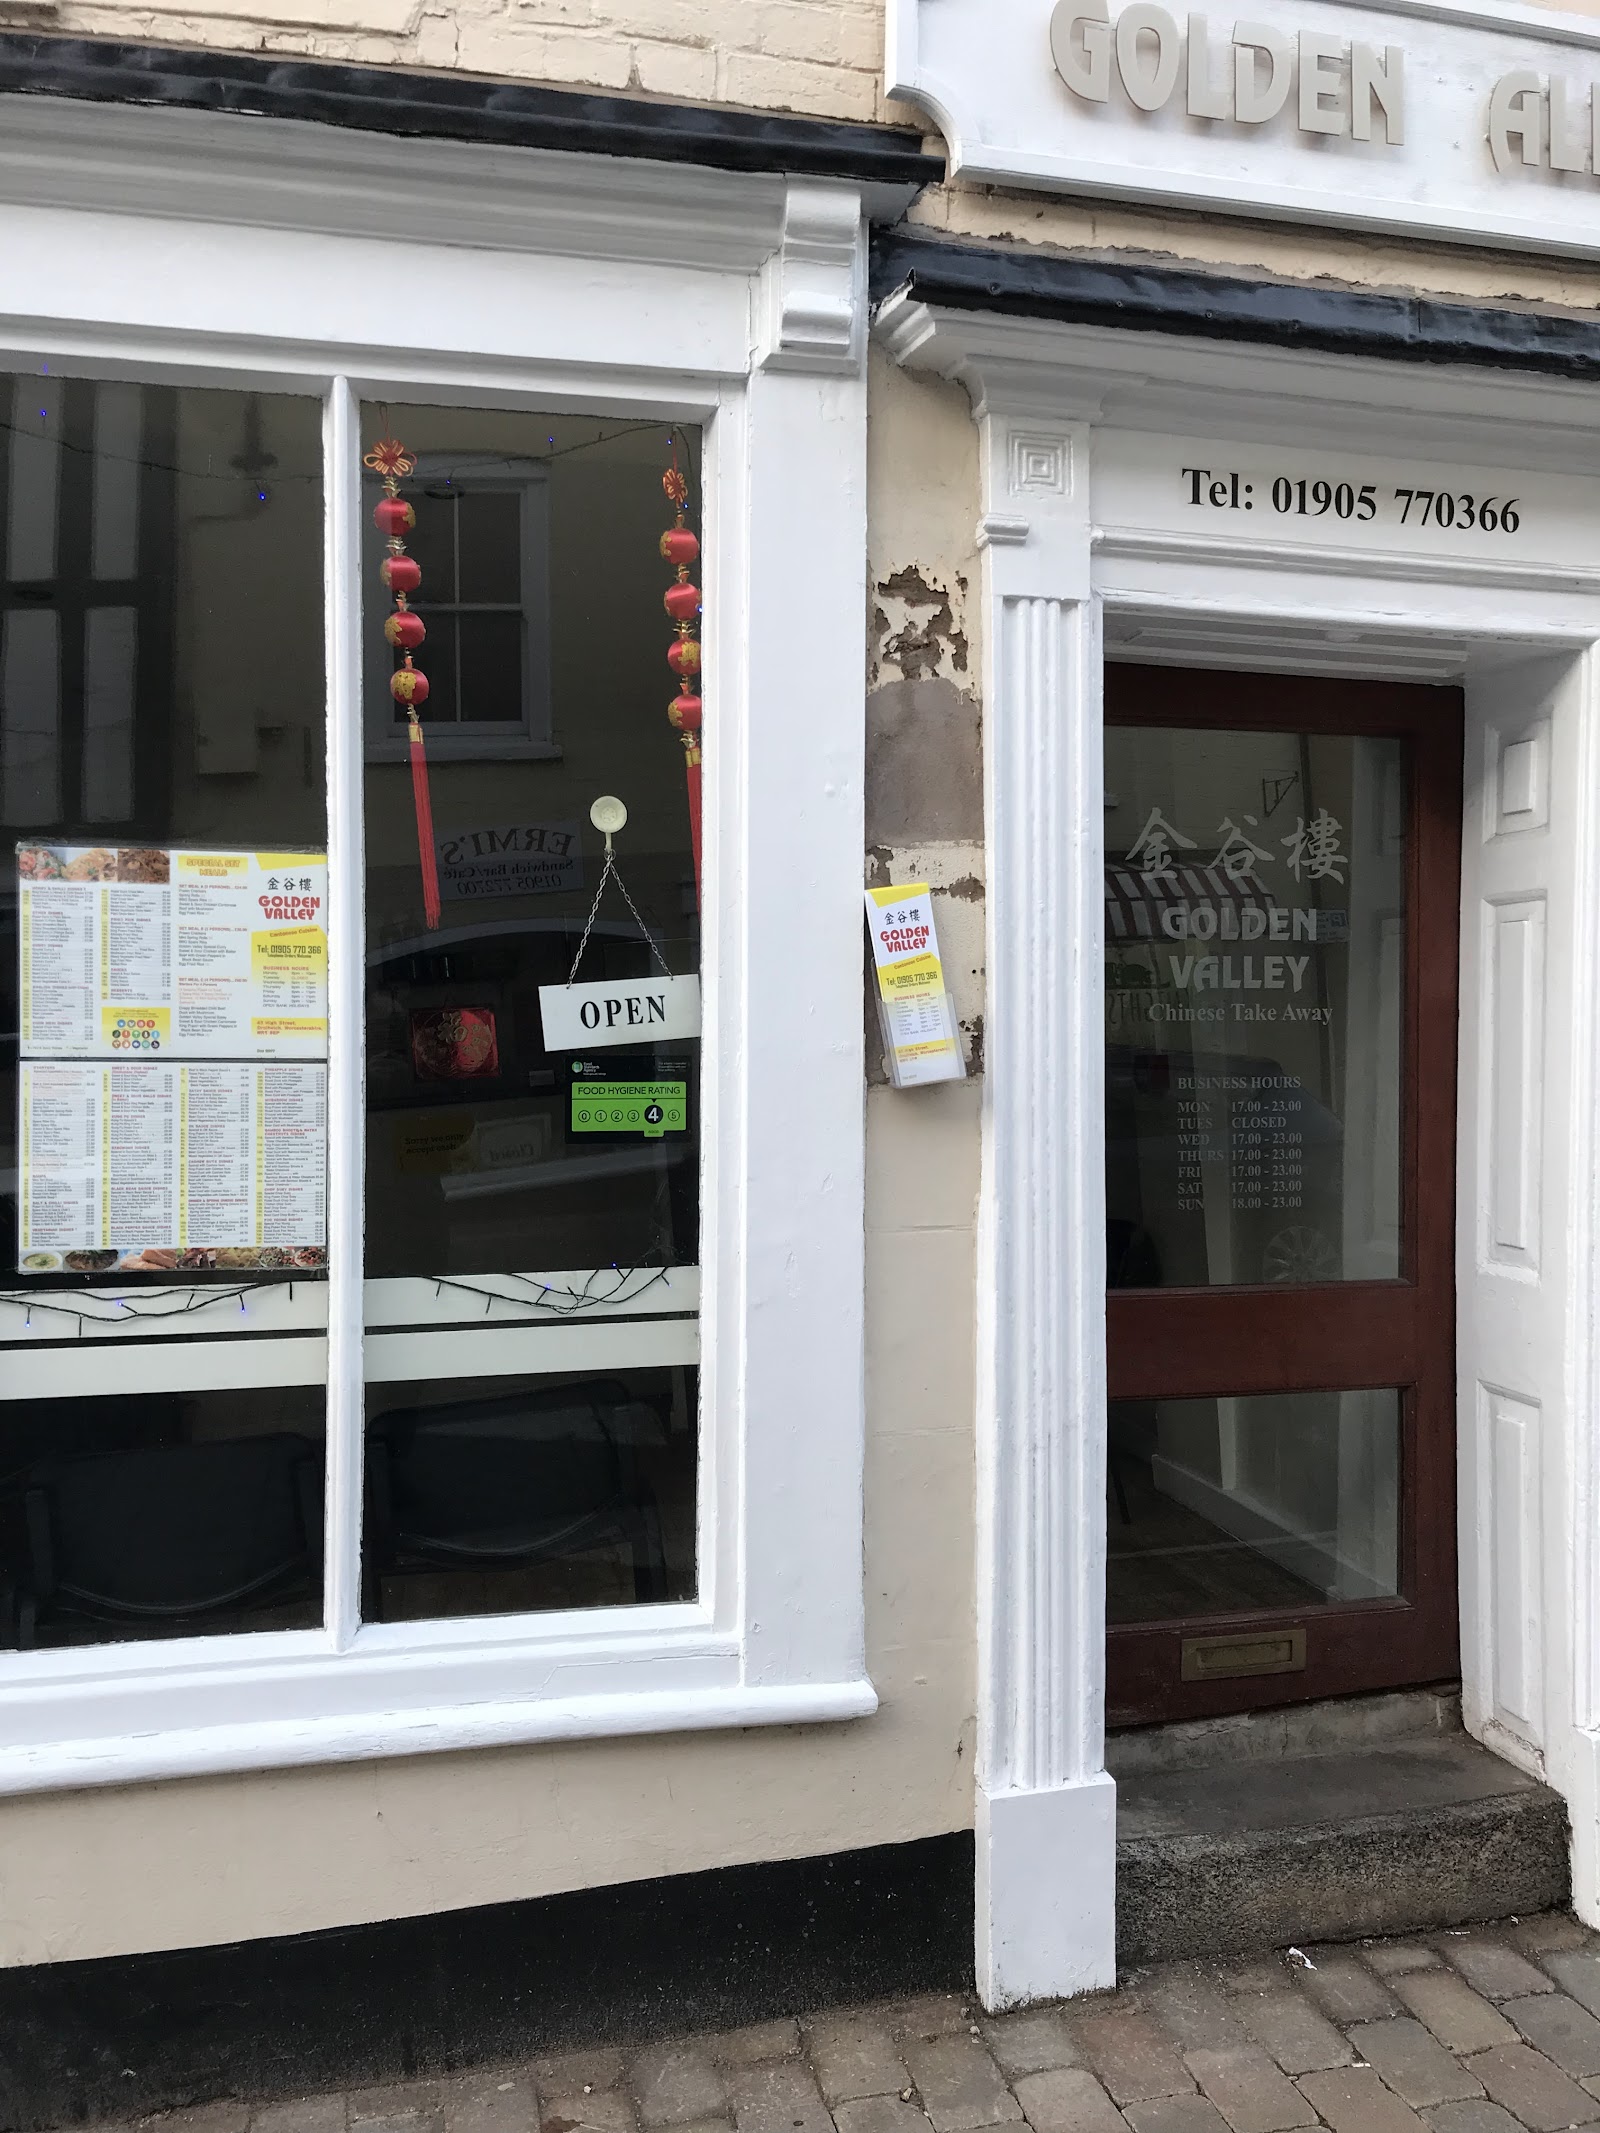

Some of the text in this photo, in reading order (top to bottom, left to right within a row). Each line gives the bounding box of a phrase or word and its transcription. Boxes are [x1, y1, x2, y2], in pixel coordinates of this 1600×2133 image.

[1049, 0, 1600, 176] GOLDEN AL
[1182, 467, 1520, 533] Tel: 01905 770366
[1125, 807, 1348, 885] 金谷樓
[267, 877, 312, 891] 金谷樓
[258, 895, 320, 908] GOLDEN
[264, 908, 314, 920] VALLEY
[884, 908, 921, 925] 金谷樓
[1162, 907, 1316, 940] GOLDEN
[880, 925, 930, 942] GOLDEN
[271, 945, 291, 953] 01905
[293, 946, 306, 954] 770
[308, 946, 321, 954] 366
[885, 937, 927, 953] VALLEY
[896, 975, 913, 984] 01905
[913, 973, 925, 982] 770
[926, 971, 937, 980] 366
[1169, 955, 1309, 992] VALLEY
[580, 995, 665, 1028] OPEN
[1149, 1003, 1225, 1021] Chinese
[1231, 1003, 1277, 1021] Take
[1283, 1003, 1334, 1026] Away
[1178, 1077, 1301, 1088] BUSINESS HOURS
[1177, 1102, 1210, 1113] MON
[1232, 1101, 1261, 1112] 17.00
[1272, 1101, 1302, 1111] 23.00
[582, 1112, 587, 1120] 0
[615, 1112, 620, 1120] 2
[631, 1112, 636, 1120] 3
[648, 1107, 659, 1122] 4
[1177, 1117, 1286, 1129] TUES CLOSED
[1177, 1134, 1210, 1145] WED
[1232, 1133, 1261, 1144] 17.00
[1272, 1133, 1302, 1144] 23.00
[1232, 1150, 1261, 1161] 17.00
[1272, 1149, 1302, 1160] 23.00
[1177, 1167, 1201, 1177] FRI
[1232, 1166, 1261, 1176] 17.00
[1272, 1165, 1302, 1176] 23.00
[1177, 1182, 1203, 1194] SAT
[1232, 1182, 1261, 1193] 17.00
[1272, 1181, 1302, 1192] 23.00
[1232, 1197, 1261, 1208] 18.00
[1272, 1197, 1302, 1208] 23.00
